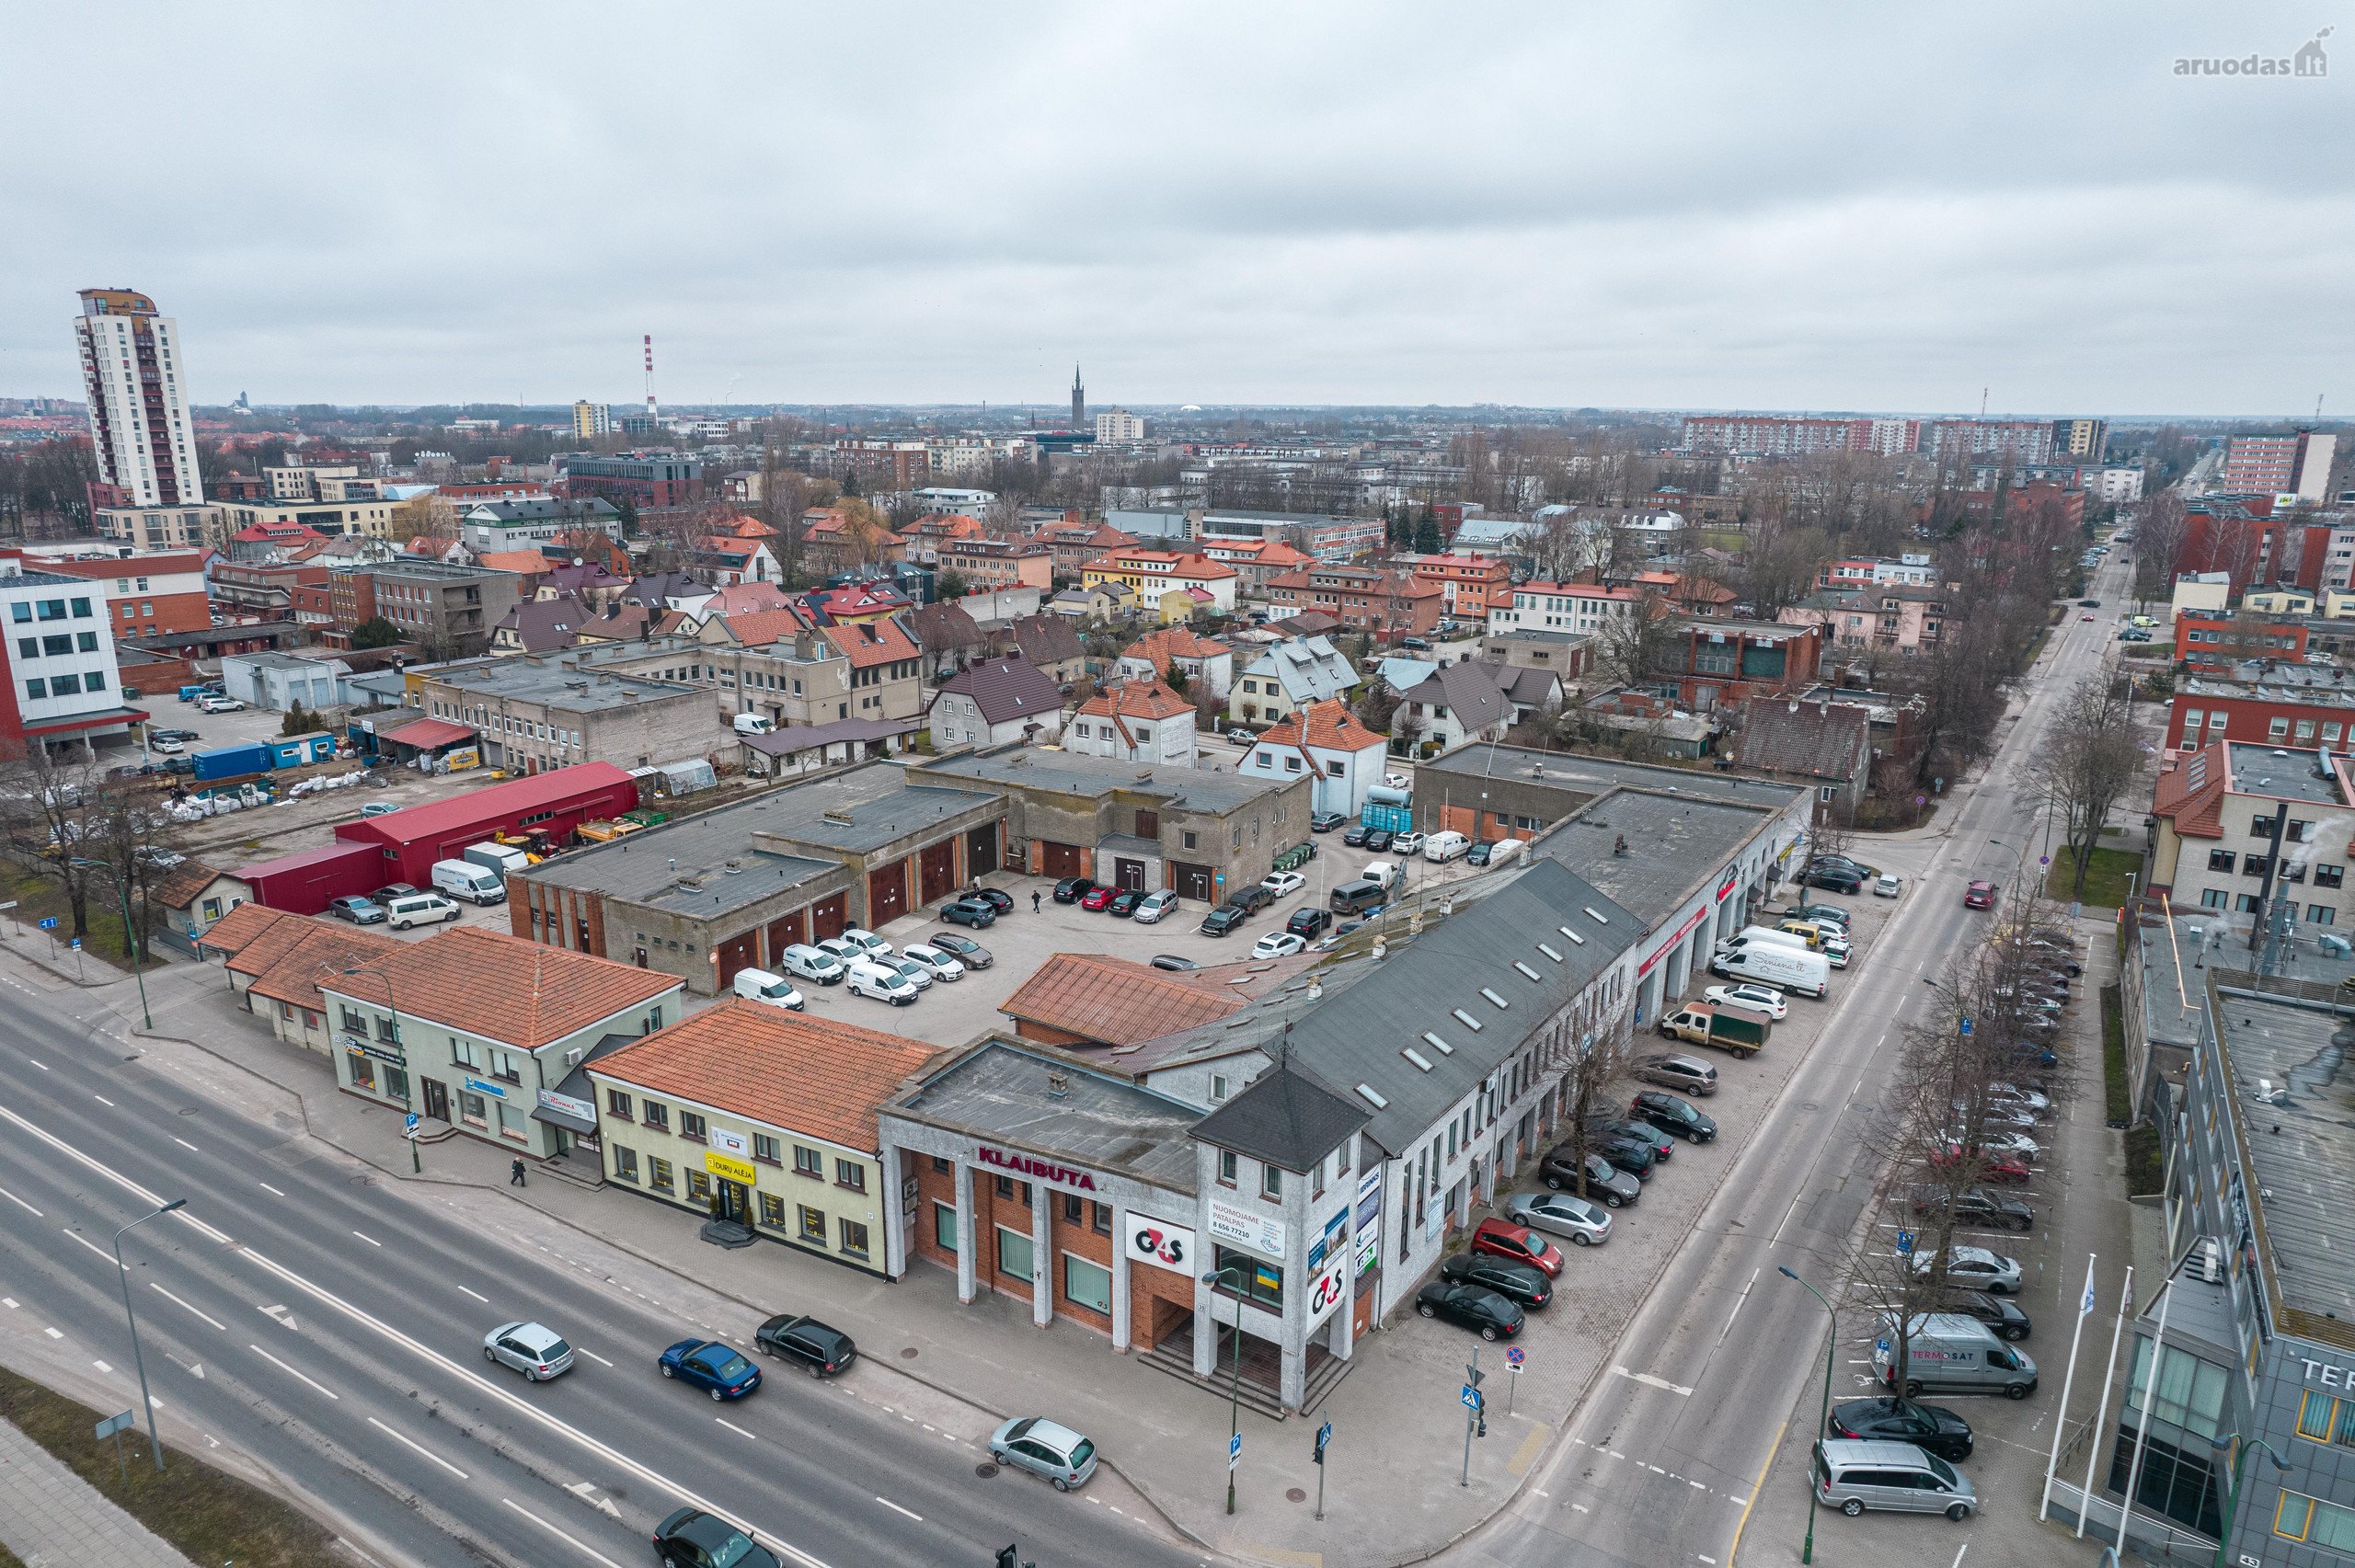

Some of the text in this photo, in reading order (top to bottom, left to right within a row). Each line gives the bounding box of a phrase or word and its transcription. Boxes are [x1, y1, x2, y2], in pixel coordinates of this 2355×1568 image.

[1680, 916, 1697, 936] SERVISAS
[409, 1115, 415, 1125] P
[715, 1162, 733, 1174] DURŲ
[733, 1168, 753, 1180] ALĖJA
[979, 1146, 1097, 1192] KLAIBUTA
[1212, 1203, 1260, 1225] NUOMOJAME
[1212, 1212, 1246, 1229] PATALPAS
[1218, 1222, 1230, 1231] 656
[1231, 1227, 1250, 1239] 77210
[1135, 1228, 1183, 1265] G4S
[1313, 1268, 1342, 1315] G4S
[1913, 1350, 1974, 1361] TERMOSAT
[1233, 1436, 1239, 1452] P
